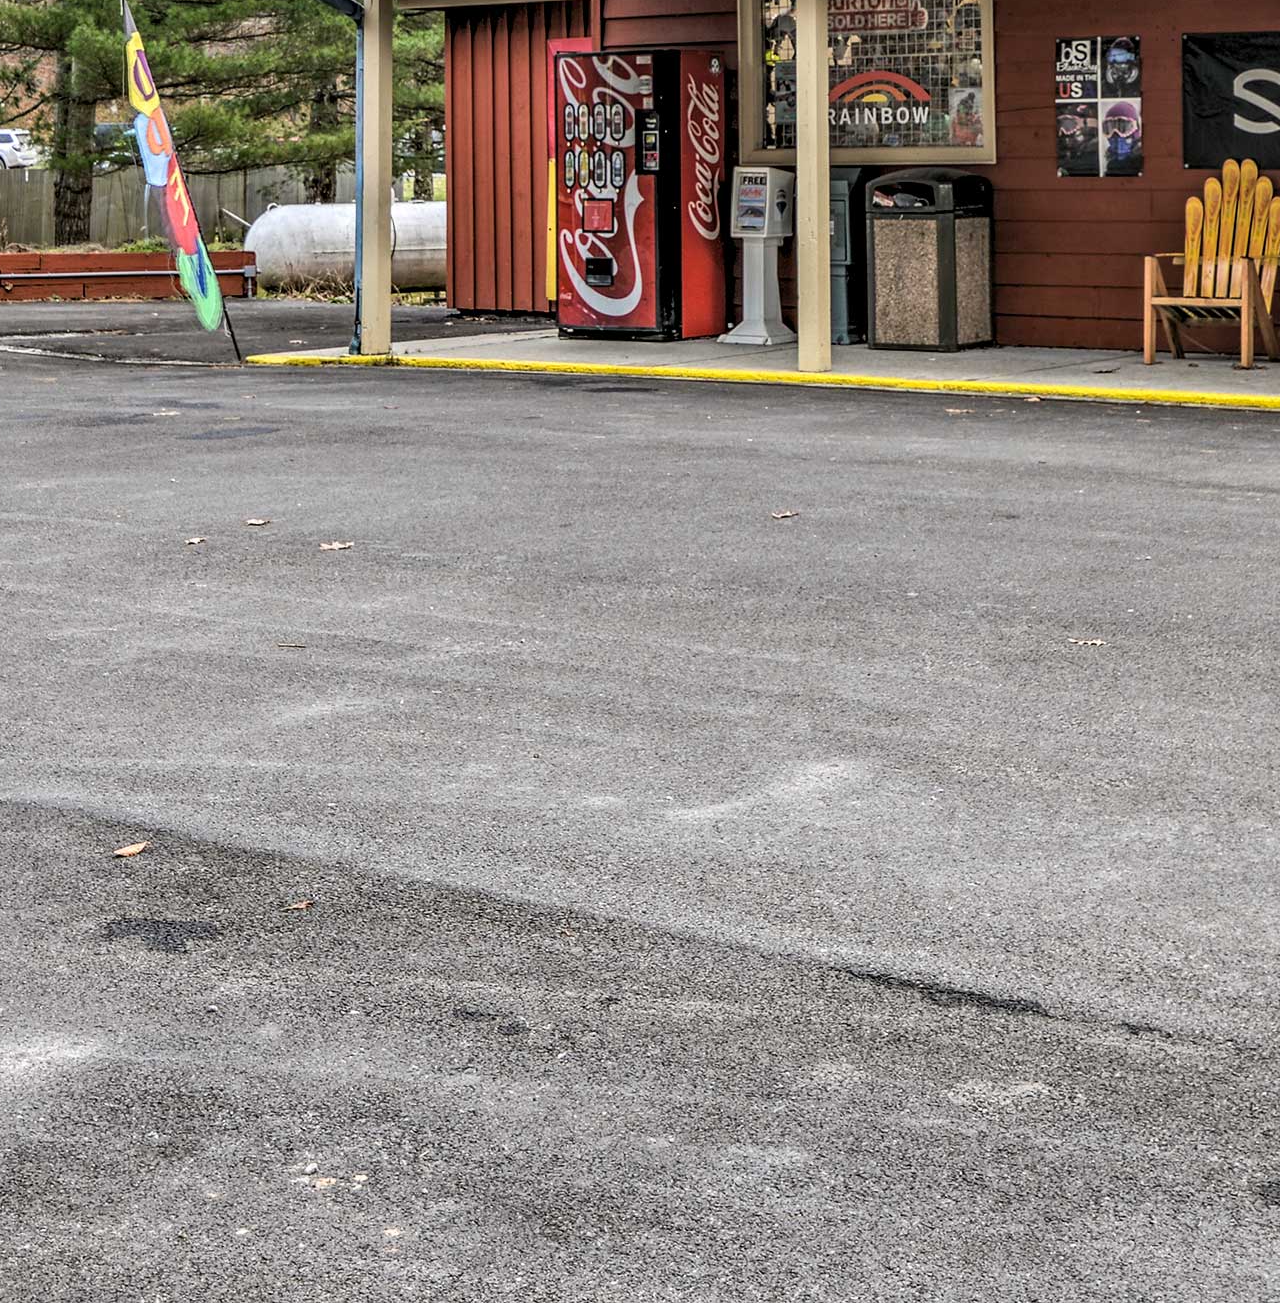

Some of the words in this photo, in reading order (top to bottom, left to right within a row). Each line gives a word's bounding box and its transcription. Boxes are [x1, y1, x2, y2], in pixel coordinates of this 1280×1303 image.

[869, 12, 907, 28] HERE
[828, 106, 929, 125] RAINBOW
[742, 176, 766, 186] FREE
